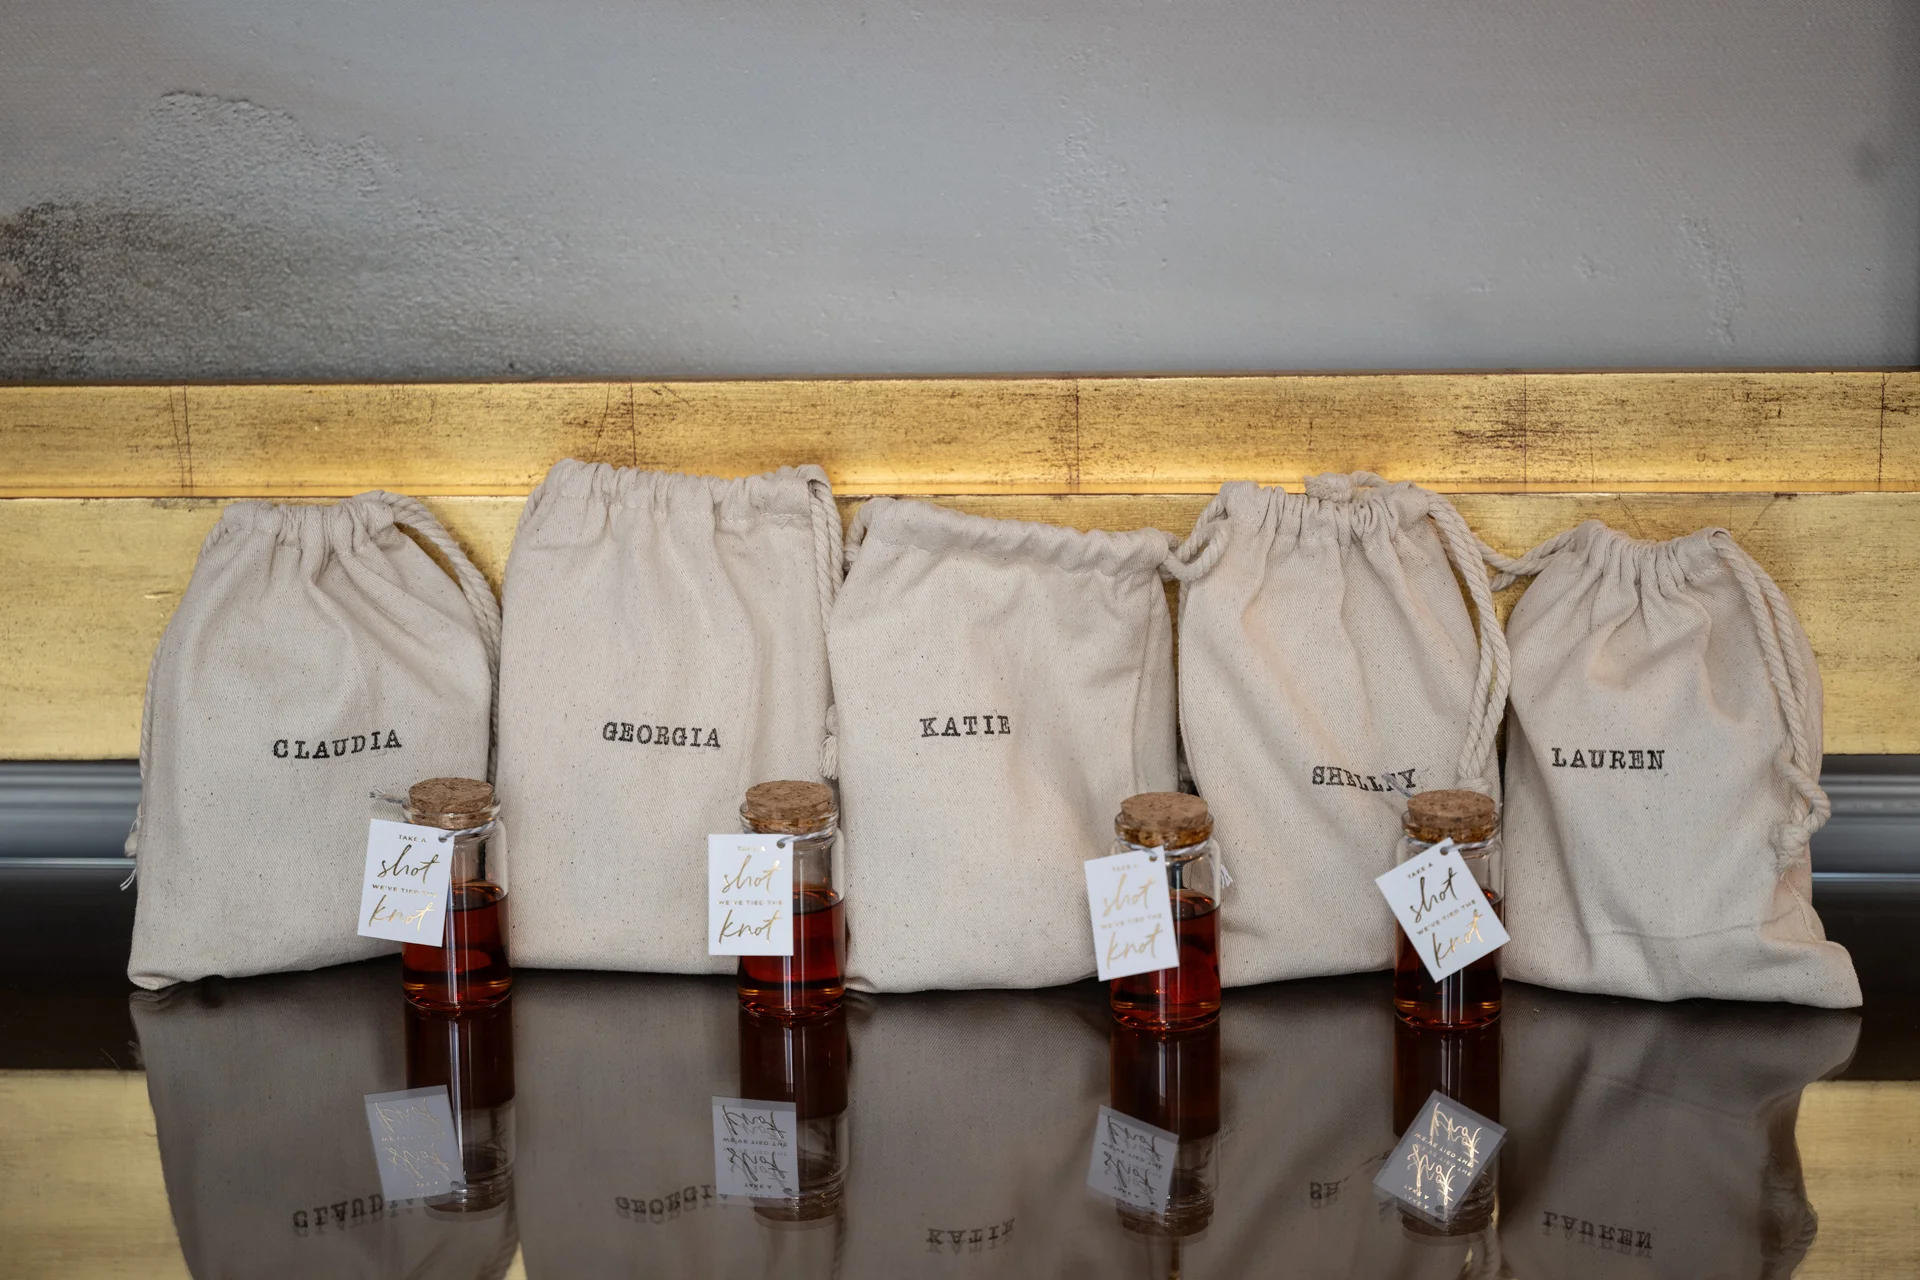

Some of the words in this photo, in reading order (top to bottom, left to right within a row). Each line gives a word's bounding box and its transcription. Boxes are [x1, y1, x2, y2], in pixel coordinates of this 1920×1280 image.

[272, 728, 403, 760] CLAUDIA
[601, 721, 721, 749] GEORGIA
[919, 714, 1012, 738] KATIE
[1550, 747, 1666, 770] LAUREN
[398, 834, 417, 842] TAKE
[377, 844, 440, 885] shot
[722, 854, 783, 895] shot
[1407, 866, 1426, 879] TAKE
[372, 883, 397, 893] WE'VE
[1103, 872, 1156, 917] shot
[1410, 867, 1459, 923] shot
[368, 894, 435, 932] knot
[718, 909, 783, 945] knot
[1416, 919, 1441, 935] WE'VE
[1442, 909, 1459, 921] TIED
[1460, 899, 1477, 911] THE
[1106, 922, 1164, 970] knot
[1432, 909, 1484, 969] knot
